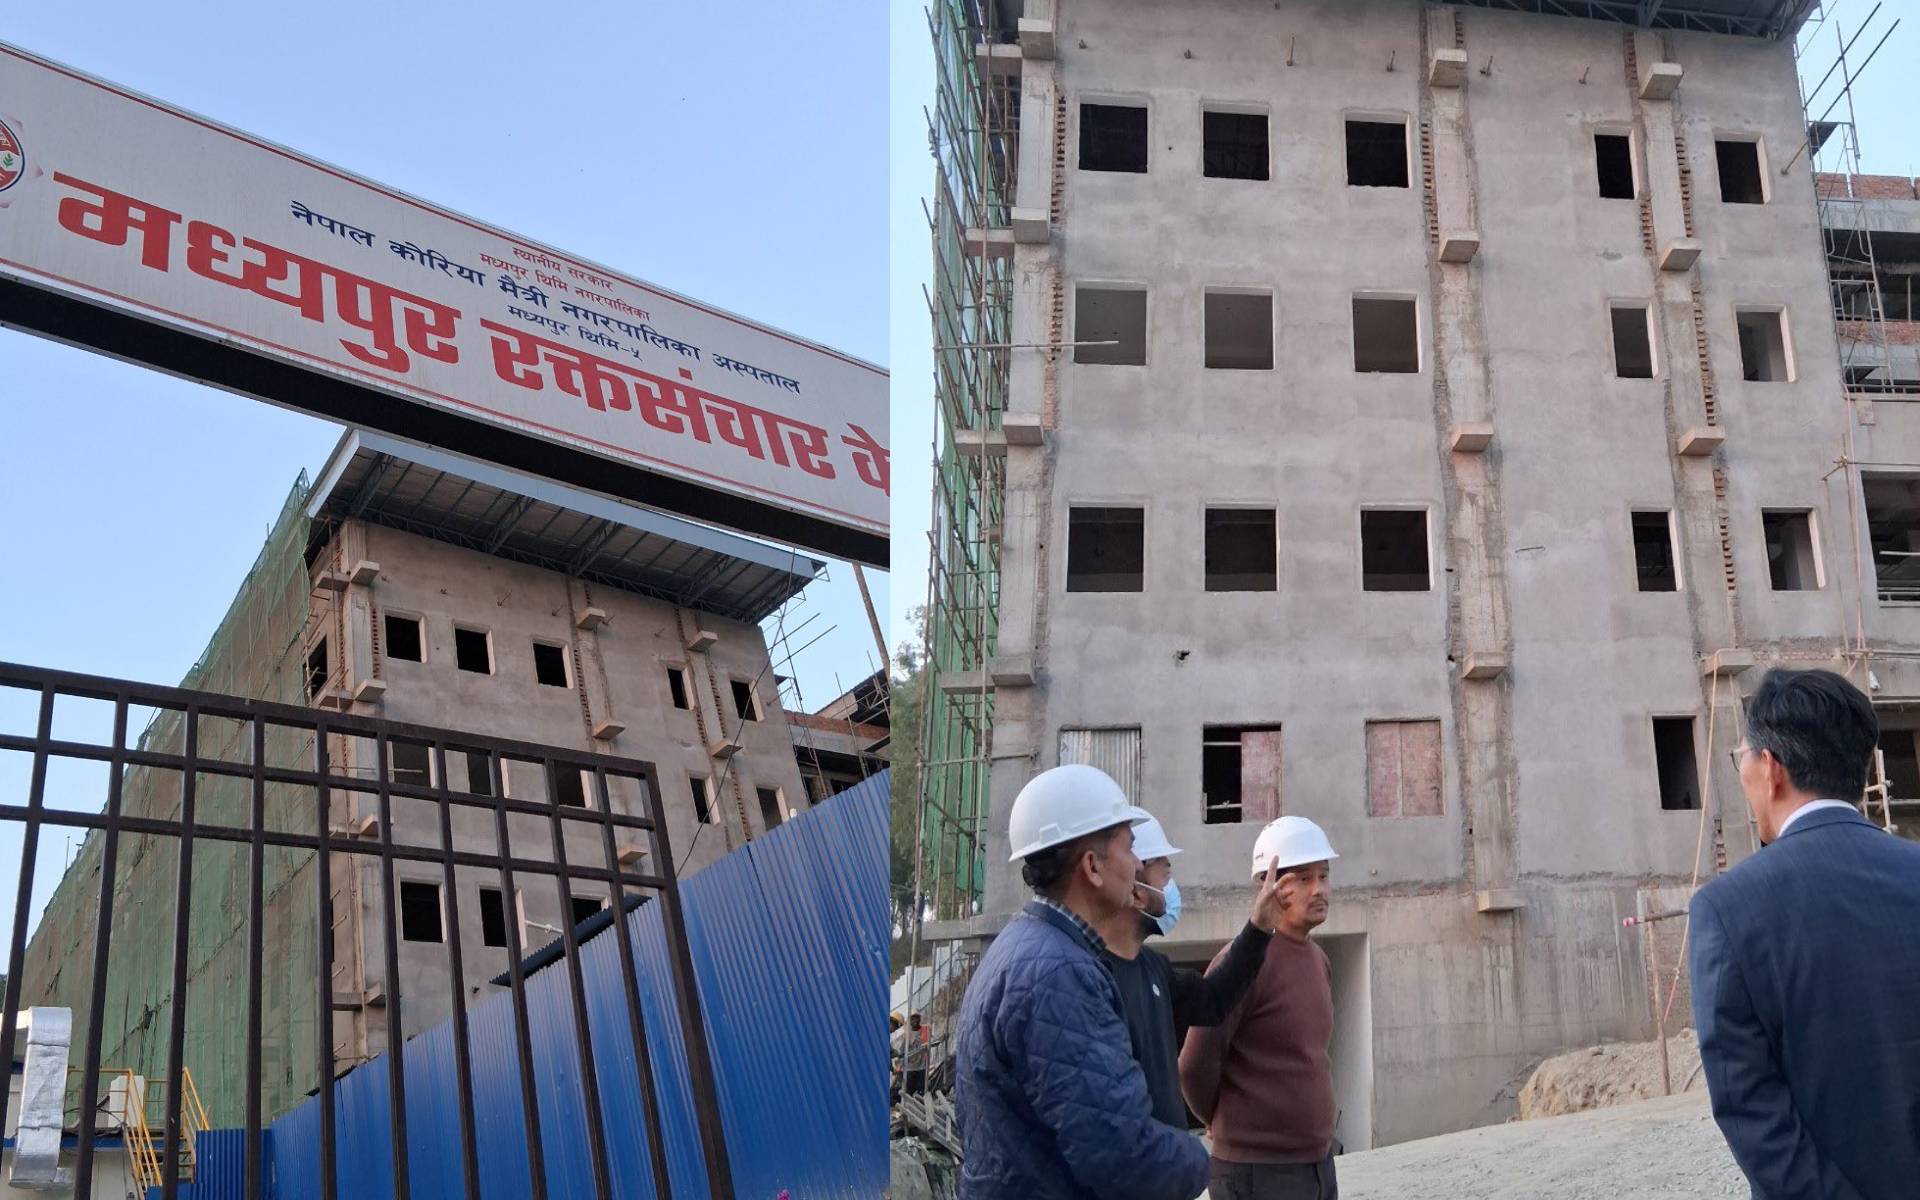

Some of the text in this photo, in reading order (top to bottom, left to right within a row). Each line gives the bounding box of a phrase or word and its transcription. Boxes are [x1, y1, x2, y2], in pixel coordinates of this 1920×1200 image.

[479, 252, 651, 321] मध्यपुर थिमि नगरपालिका
[512, 247, 613, 292] स्थानीय सरकार
[53, 171, 462, 374] मध्यपुर
[480, 317, 837, 481] रक्तसंचार
[389, 239, 486, 287] कोरिया
[498, 273, 550, 310] मैत्री
[560, 300, 701, 361] नगरपालिका
[712, 352, 800, 395] अस्पताल
[507, 304, 570, 336] मध्यपुर
